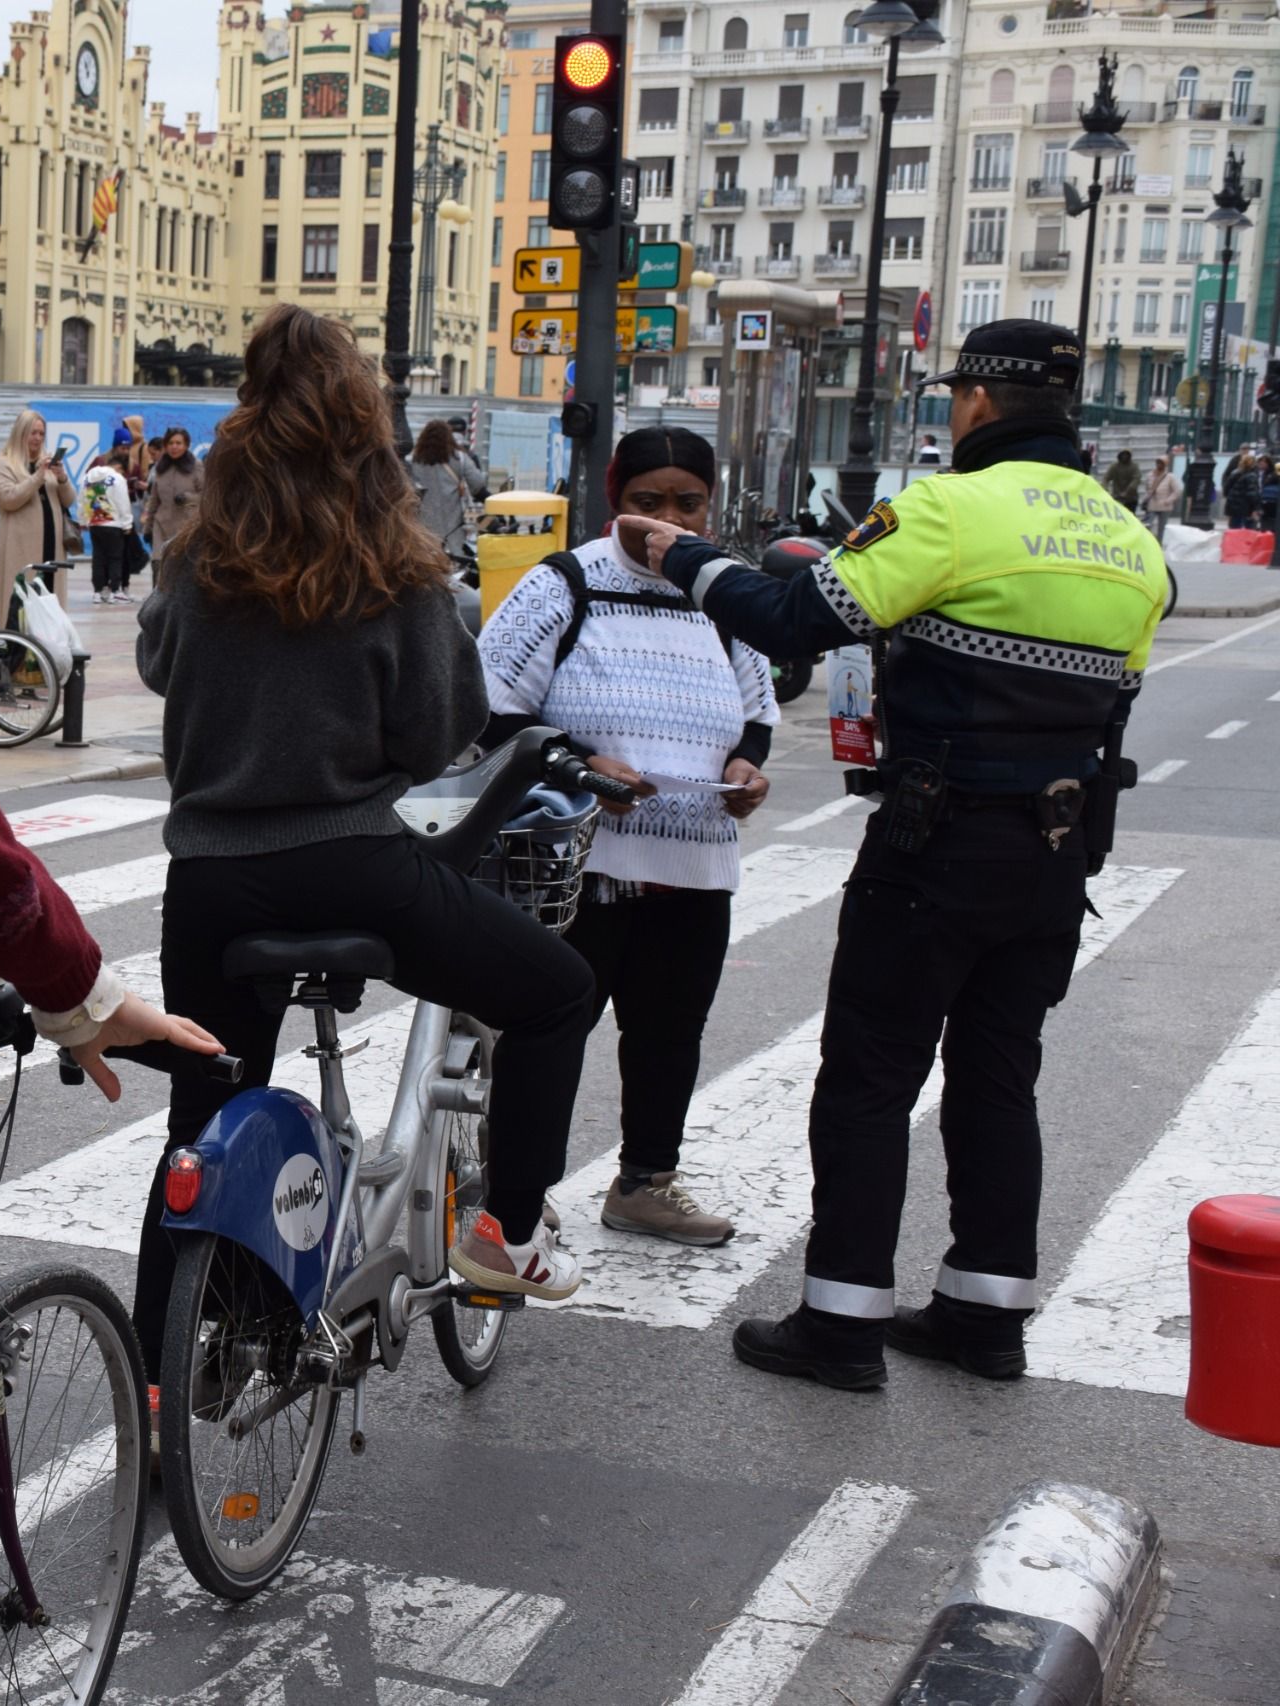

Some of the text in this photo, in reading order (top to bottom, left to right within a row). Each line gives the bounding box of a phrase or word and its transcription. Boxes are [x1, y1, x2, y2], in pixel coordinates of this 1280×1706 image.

[531, 55, 554, 76] ZE
[1022, 487, 1128, 525] POLICIA
[1059, 516, 1112, 538] LOCAL
[1020, 534, 1146, 577] VALENCIA
